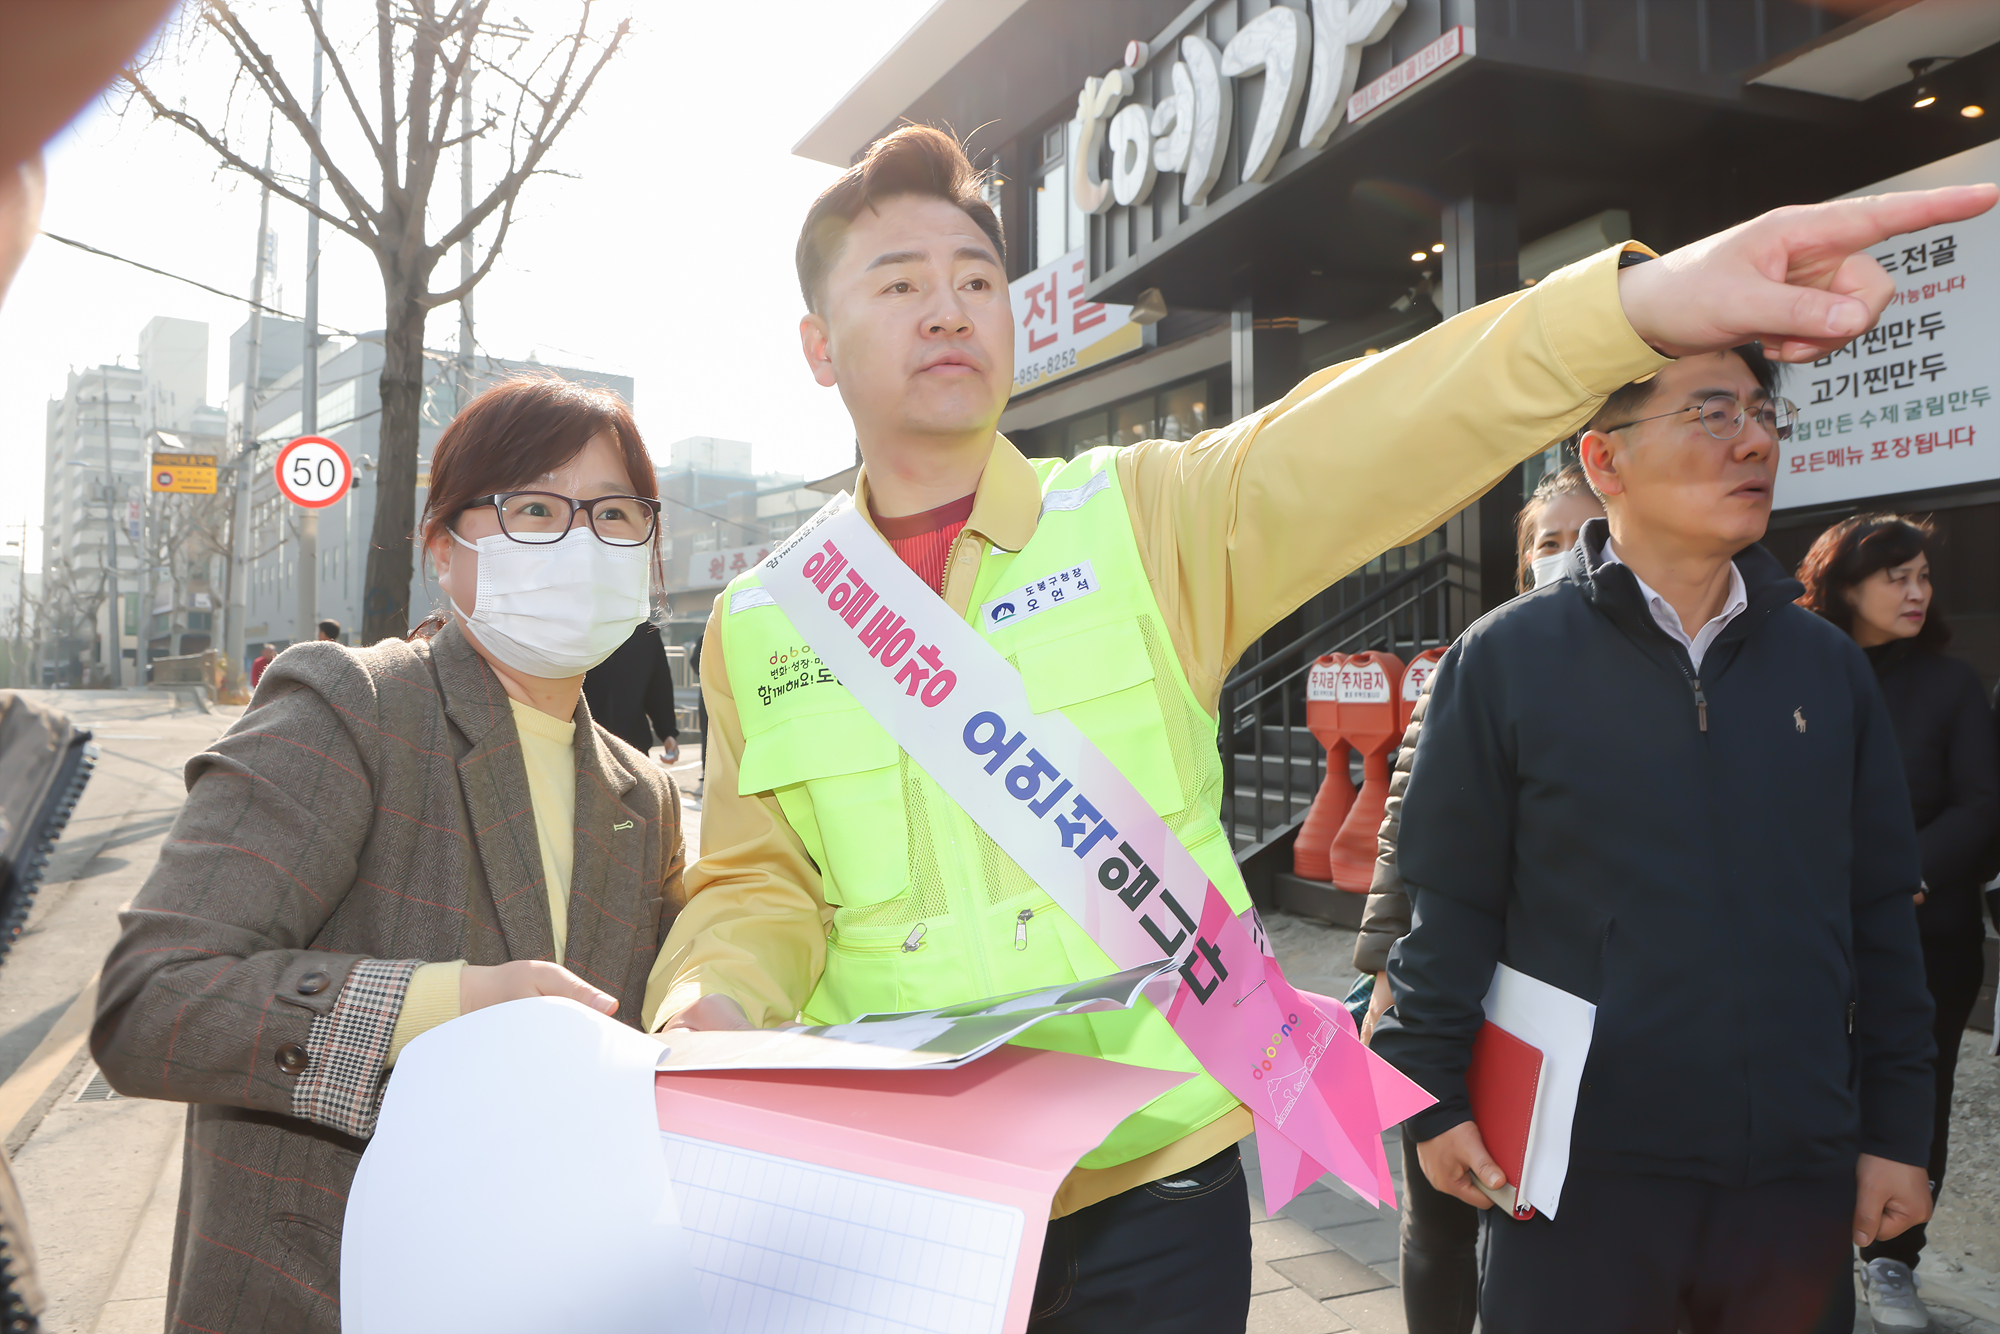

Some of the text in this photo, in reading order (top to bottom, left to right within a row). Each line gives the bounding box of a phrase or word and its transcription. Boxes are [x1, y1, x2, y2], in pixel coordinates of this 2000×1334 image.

[1891, 274, 1967, 306] 가능합니다
[1809, 352, 1948, 405] 고기찐만두
[1788, 386, 1991, 443] 접만든 수제 굴림만두
[1789, 425, 1976, 475] 모든메뉴 포장됩니다
[292, 457, 336, 488] 50
[1024, 566, 1082, 597] 도봉구청장
[768, 644, 818, 666] dobo
[757, 667, 844, 706] 함께해요! 도
[802, 538, 1230, 1006] 일일동장 오언석입니다
[1250, 1013, 1302, 1081] dobong
